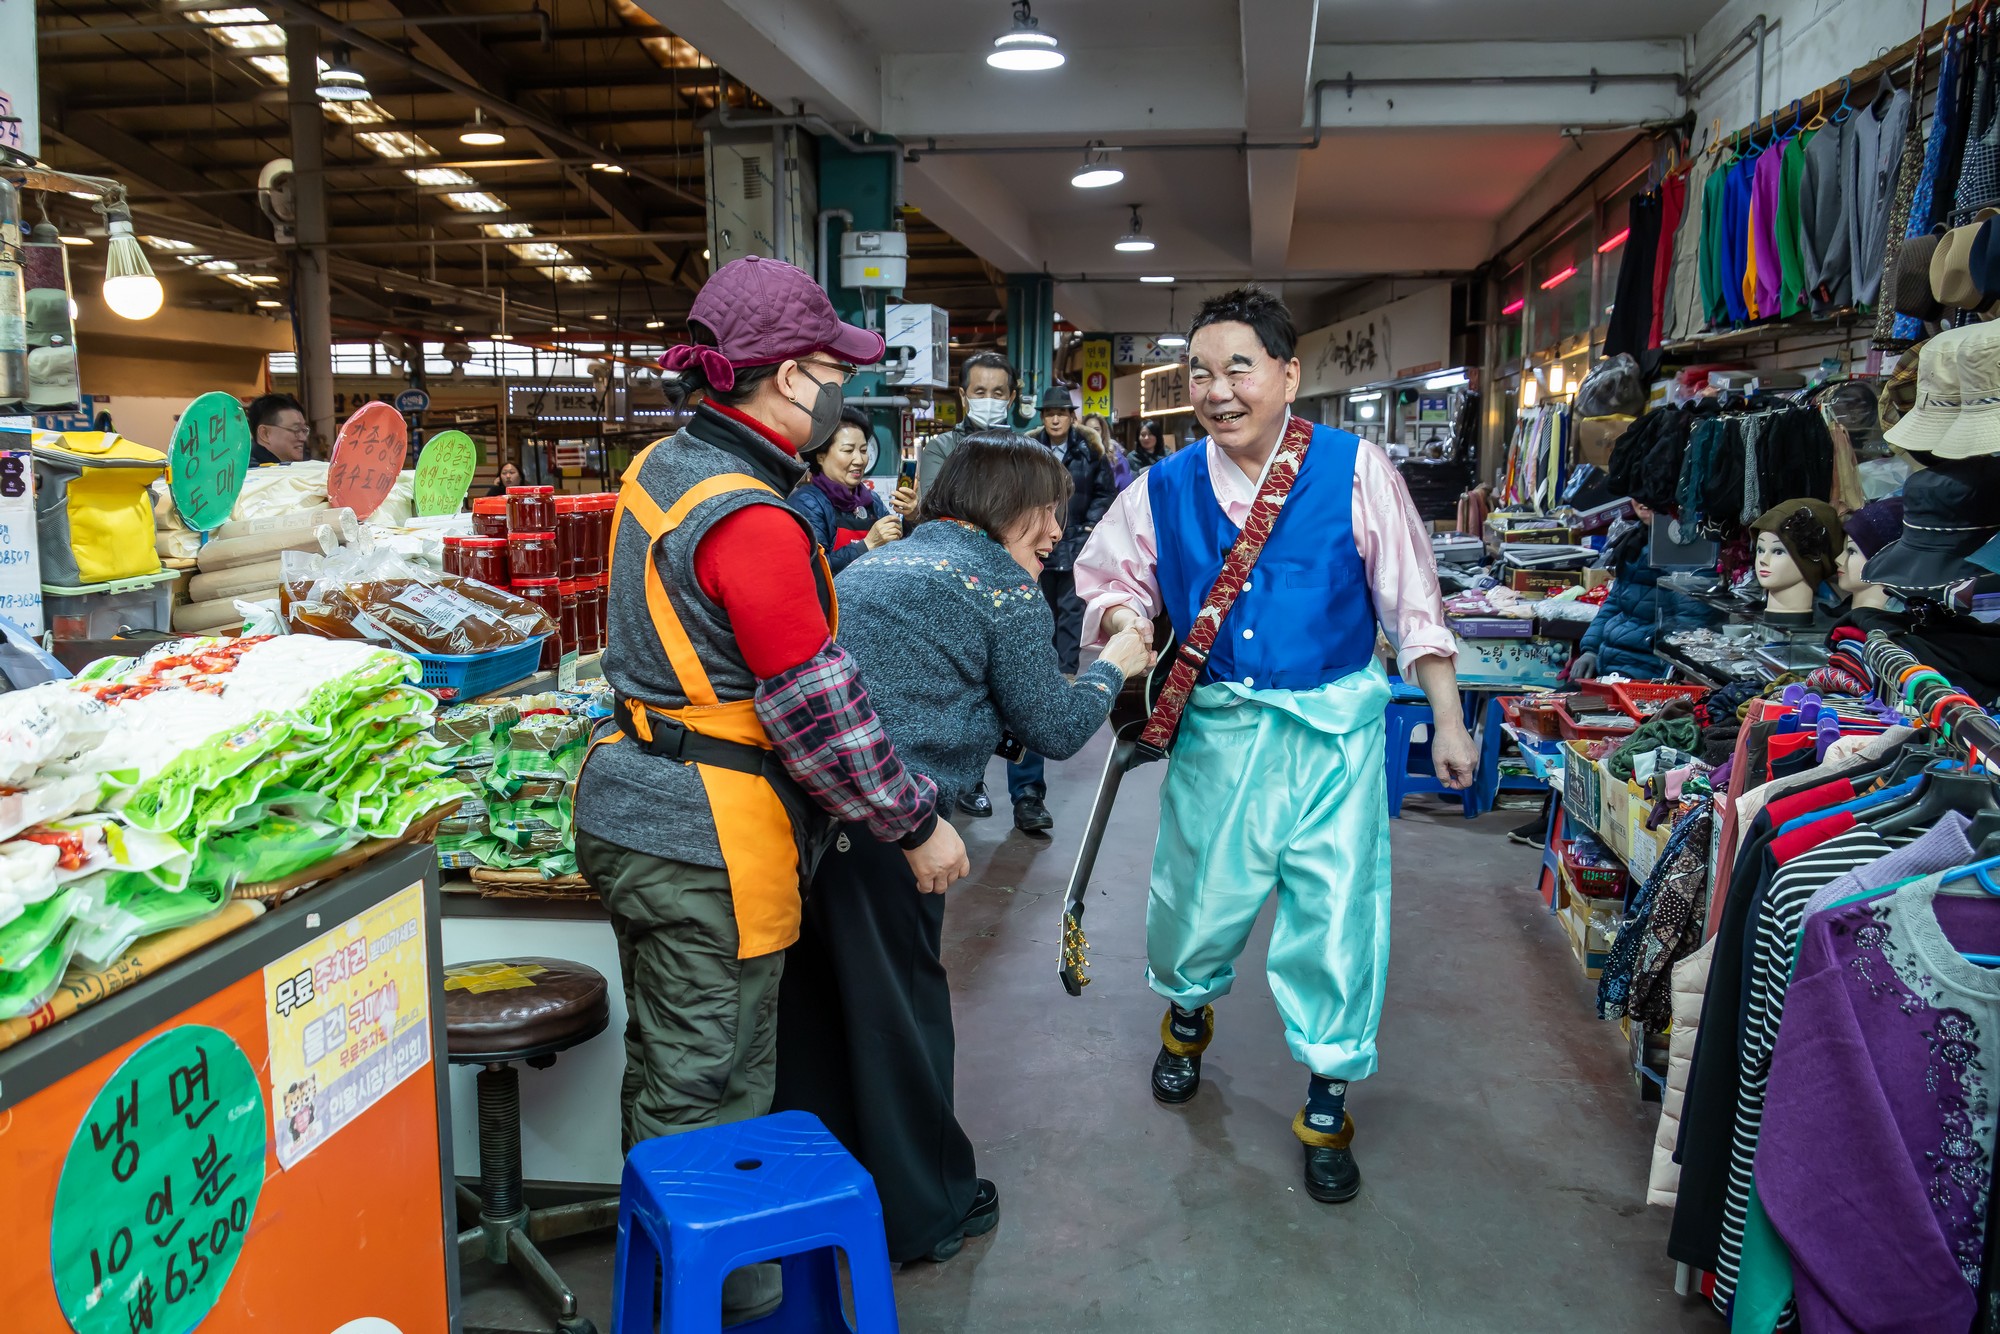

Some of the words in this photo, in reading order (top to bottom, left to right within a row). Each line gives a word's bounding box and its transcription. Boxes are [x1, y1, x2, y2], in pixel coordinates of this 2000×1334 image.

[1084, 396, 1108, 410] 수산
[1091, 374, 1103, 389] 회
[180, 407, 230, 479] 냉면
[189, 458, 234, 519] 도매
[276, 968, 315, 1017] 무료
[315, 936, 368, 994] 주차권
[303, 1002, 347, 1068] 물건
[90, 1046, 220, 1183] 냉면
